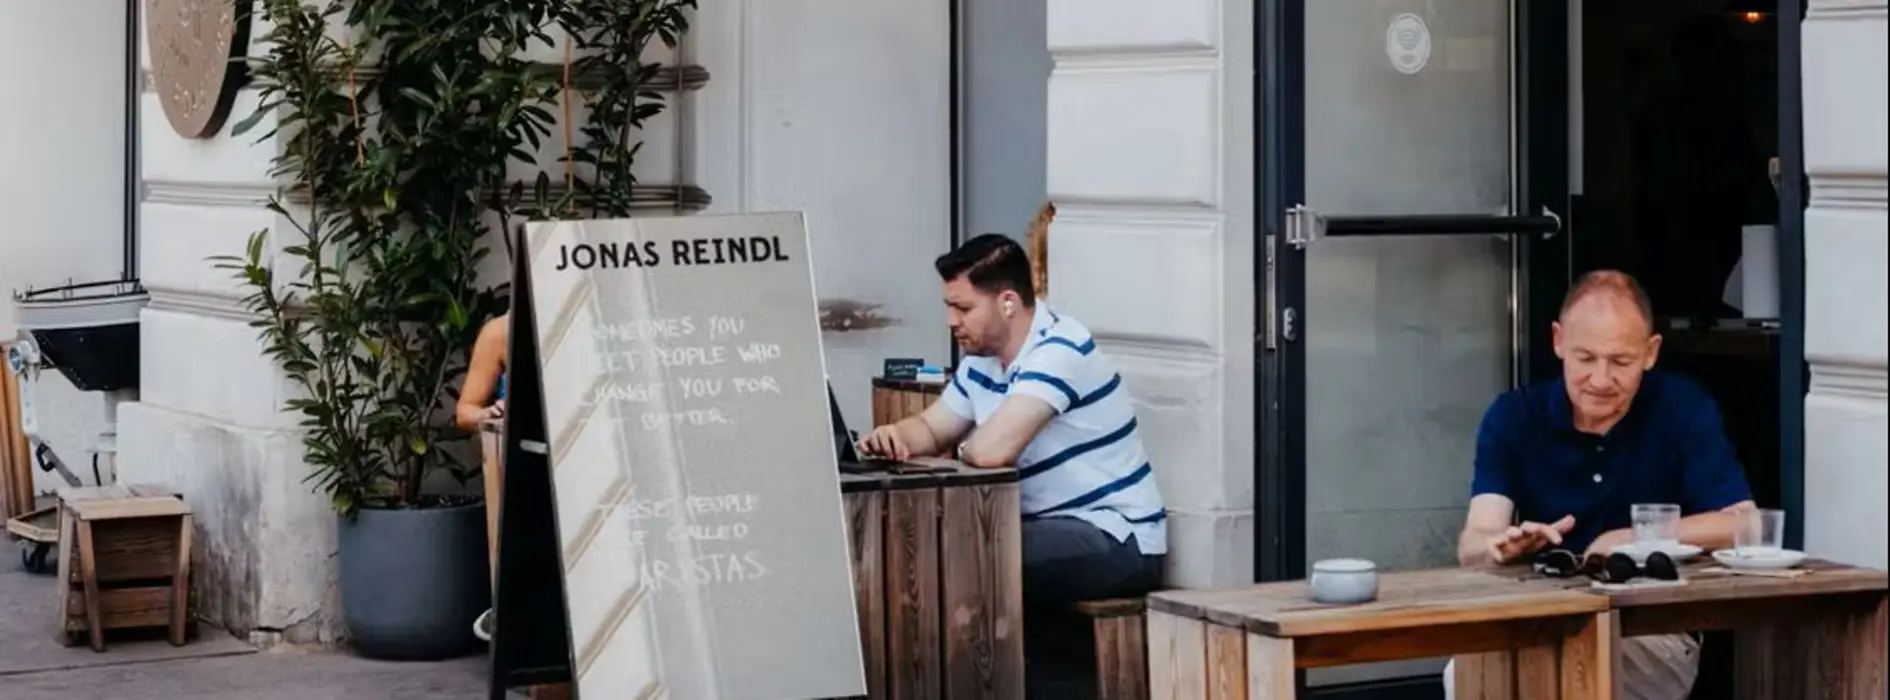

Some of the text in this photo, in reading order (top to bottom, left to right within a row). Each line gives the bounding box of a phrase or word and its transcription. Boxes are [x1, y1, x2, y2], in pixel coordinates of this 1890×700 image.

[556, 235, 789, 271] JONAS REINDL
[586, 315, 745, 342] OMEMES YOU
[651, 346, 728, 368] PEOPLE
[736, 341, 781, 364] WHO
[678, 376, 722, 400] YOU
[732, 375, 782, 396] FOR
[598, 494, 757, 518] TESE PEOPLE
[666, 522, 749, 542] CALLED
[630, 550, 767, 590] ARISTAS
